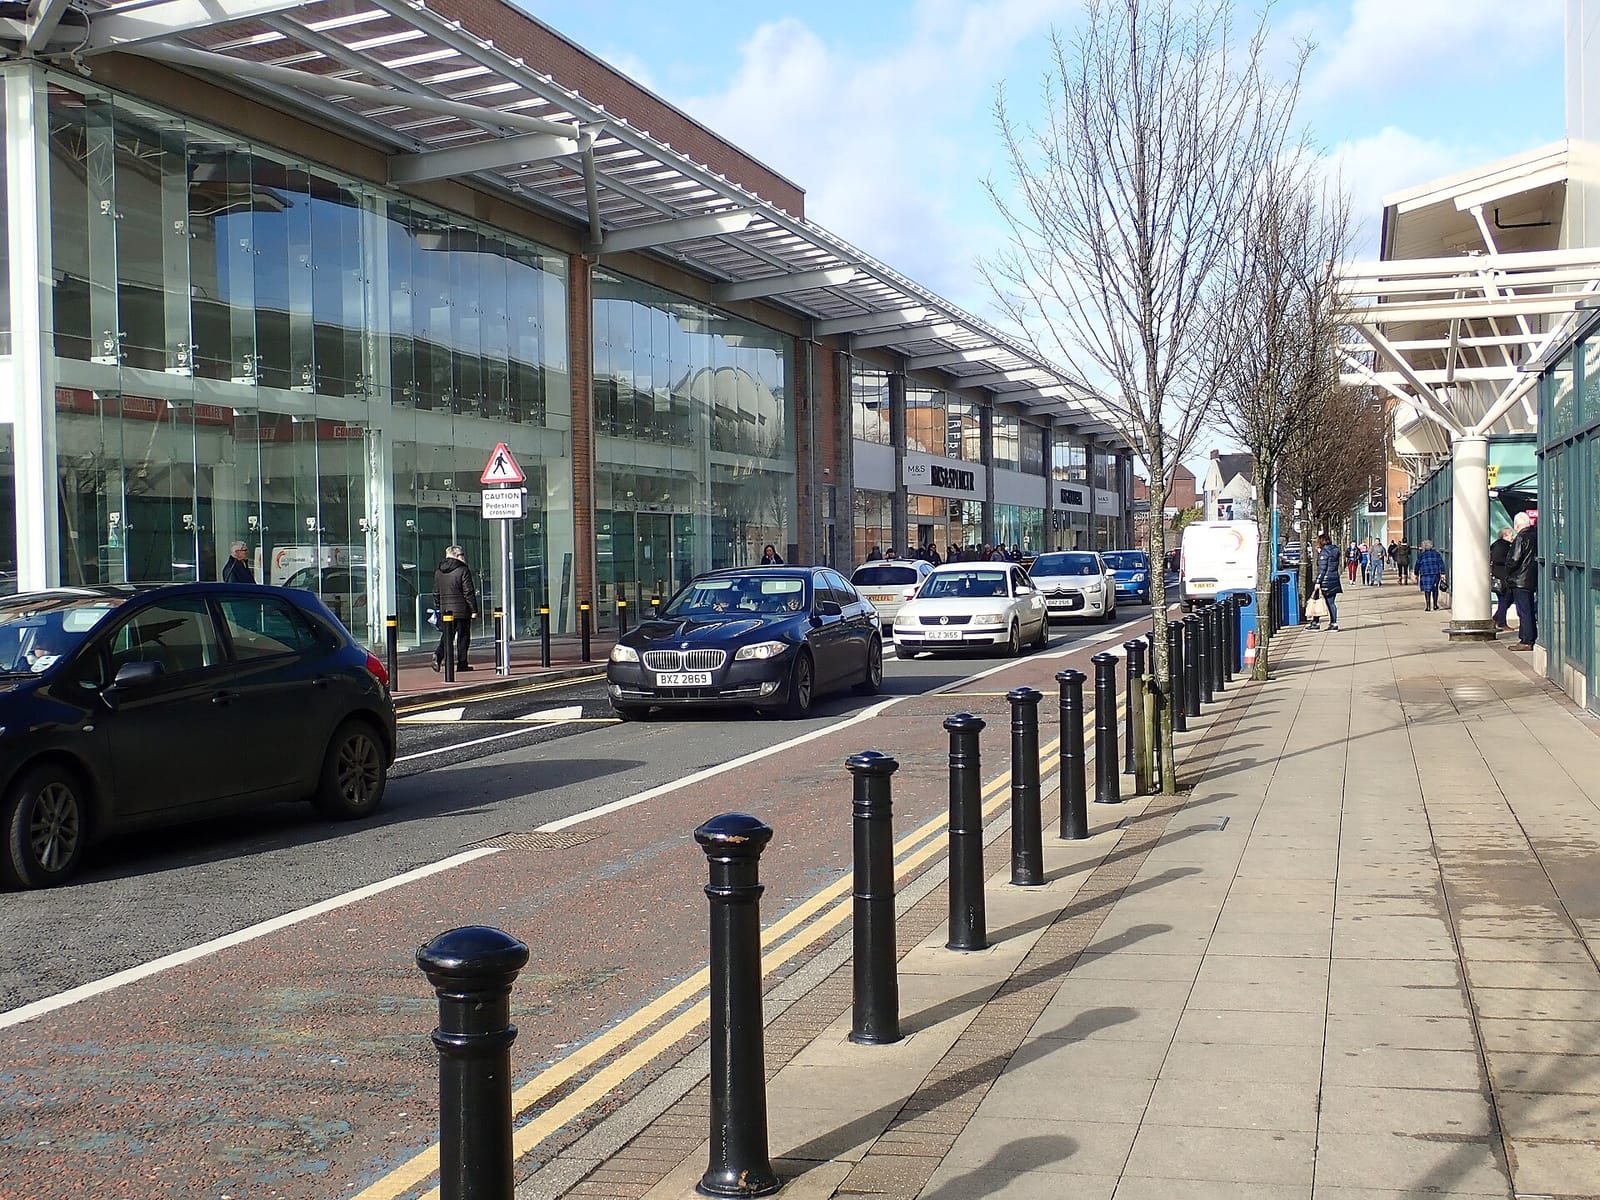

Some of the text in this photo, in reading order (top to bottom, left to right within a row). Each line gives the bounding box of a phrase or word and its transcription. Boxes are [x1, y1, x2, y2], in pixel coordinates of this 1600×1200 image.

[907, 465, 926, 473] M&S
[661, 674, 707, 684] BXZ 2869
